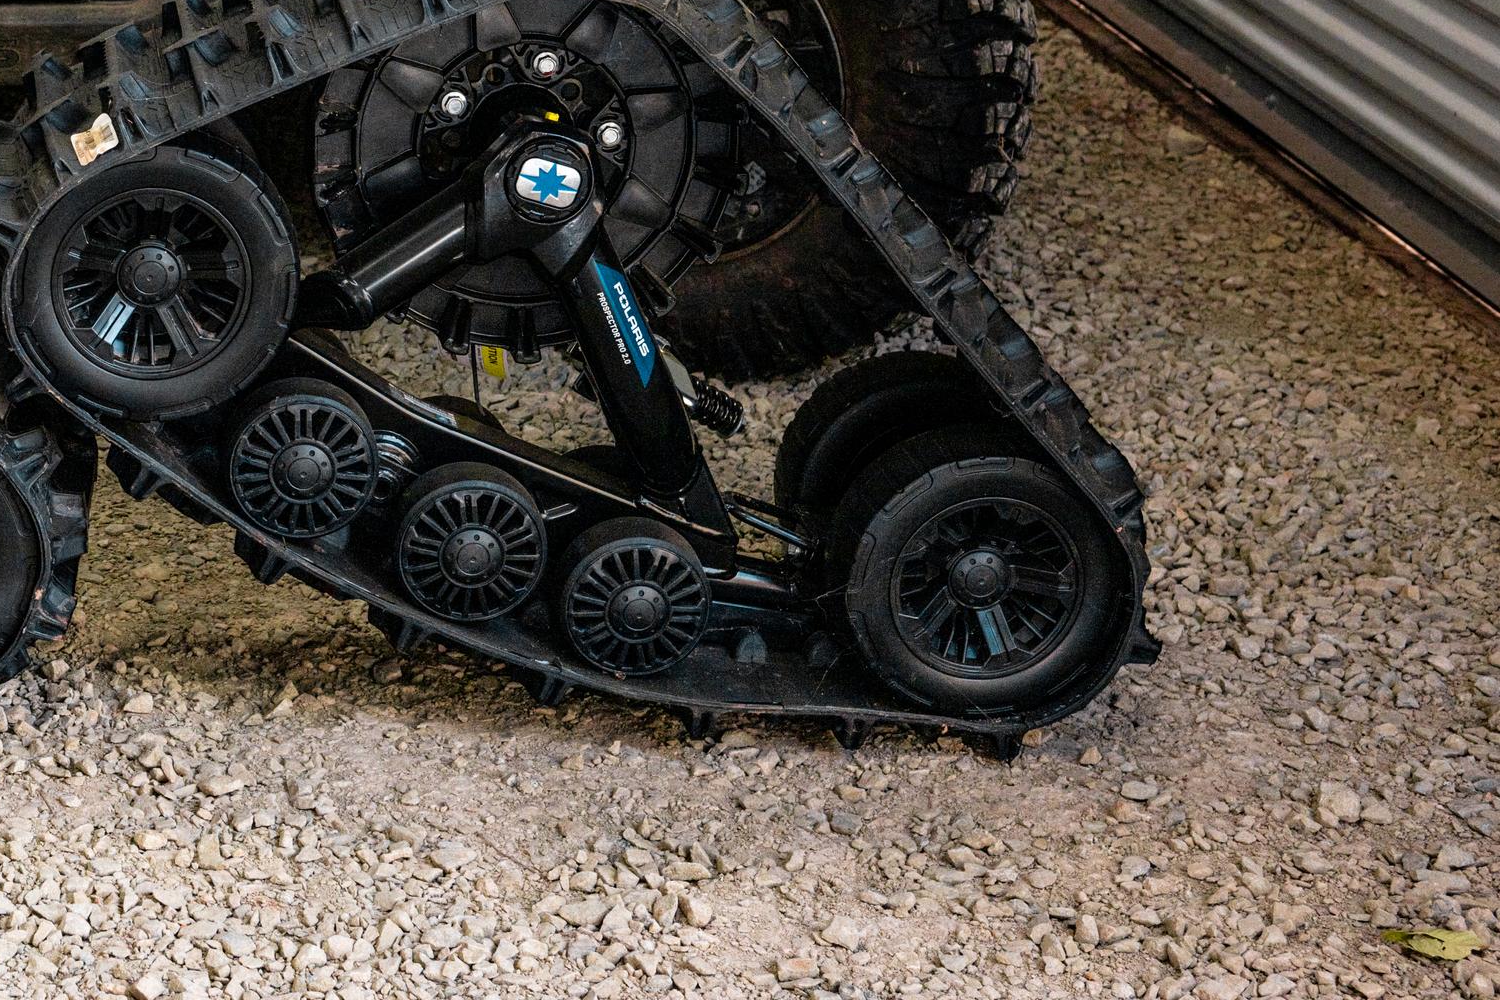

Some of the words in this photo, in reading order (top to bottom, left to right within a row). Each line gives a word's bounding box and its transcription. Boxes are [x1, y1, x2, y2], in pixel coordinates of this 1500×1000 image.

[597, 292, 621, 338] PROSPECTOR
[616, 339, 626, 353] PRO
[621, 353, 631, 365] 2.0
[613, 281, 650, 357] POLARIS
